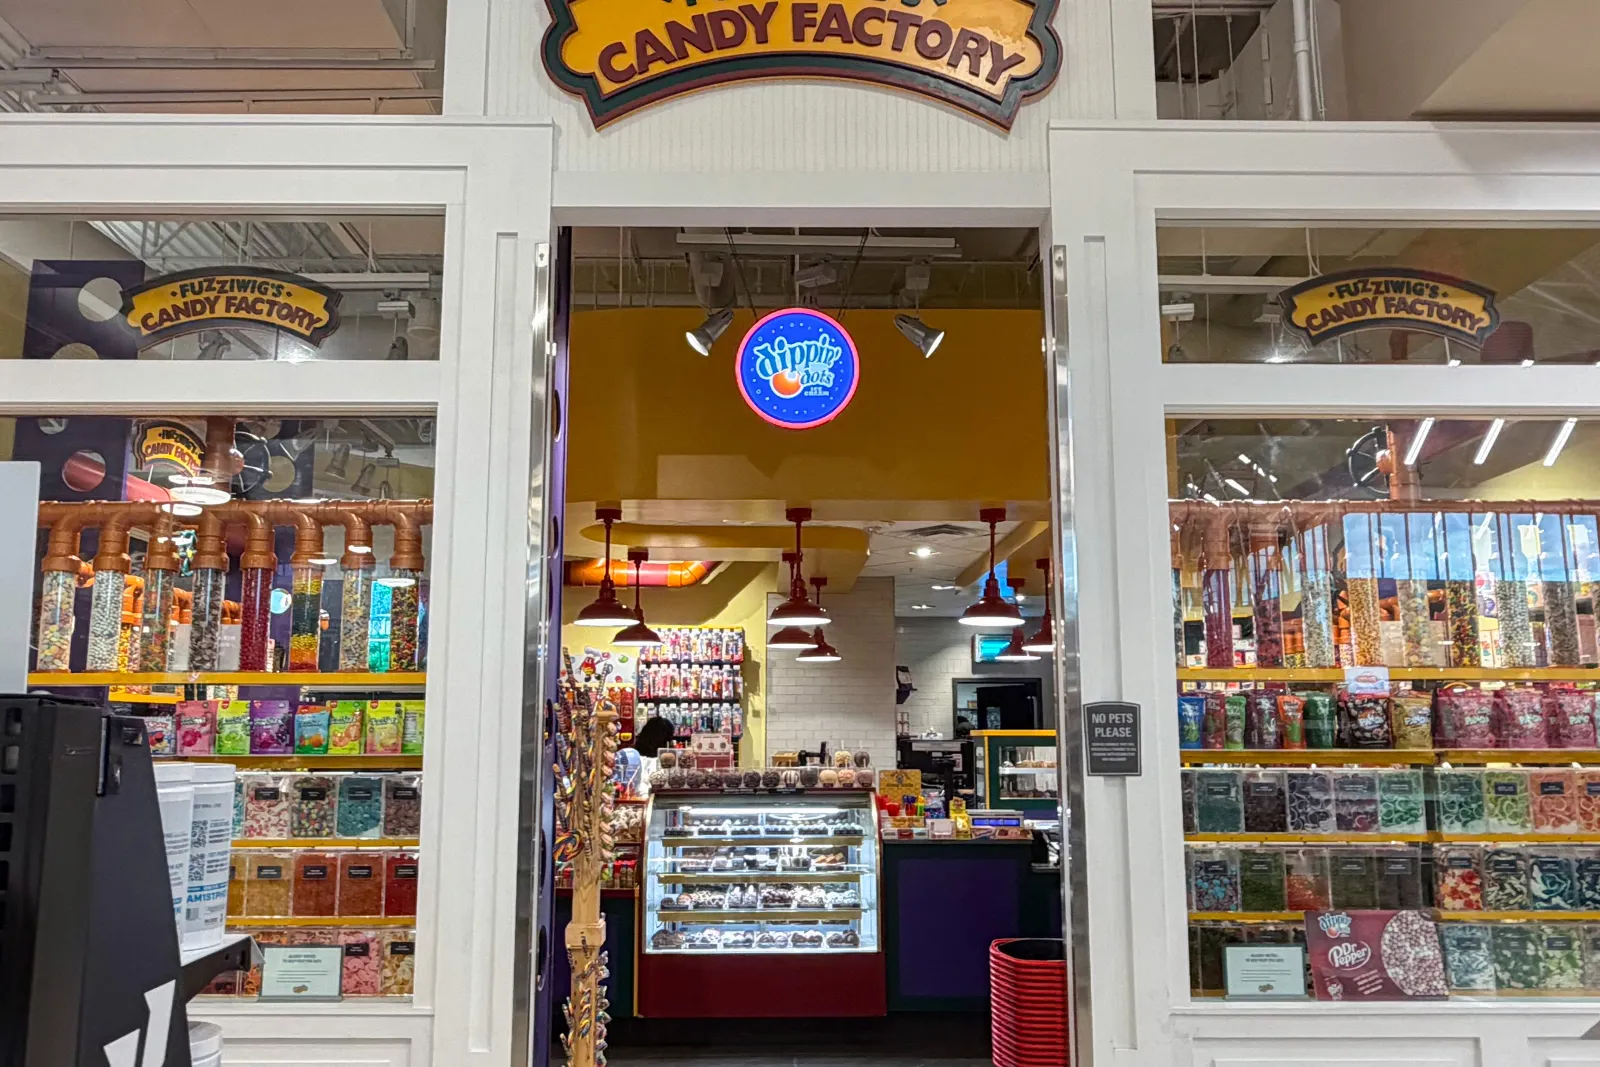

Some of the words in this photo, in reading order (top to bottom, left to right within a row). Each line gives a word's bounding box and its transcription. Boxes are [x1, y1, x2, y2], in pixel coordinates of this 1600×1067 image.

[599, 2, 779, 83] CANDY
[790, 2, 1026, 84] FACTORY
[179, 277, 285, 298] FUZZIWIG'S
[1335, 279, 1440, 299] FUZZIWIG'S
[141, 296, 221, 331] CANDY
[224, 296, 323, 331] FACTORY
[1305, 296, 1379, 332] CANDY
[1384, 296, 1485, 331] FACTORY
[800, 368, 834, 387] dots
[1091, 713, 1106, 724] NO
[1108, 713, 1134, 724] PETS
[1094, 727, 1132, 738] PLEASE
[1333, 945, 1368, 968] Pepper
[1341, 943, 1358, 956] Dr
